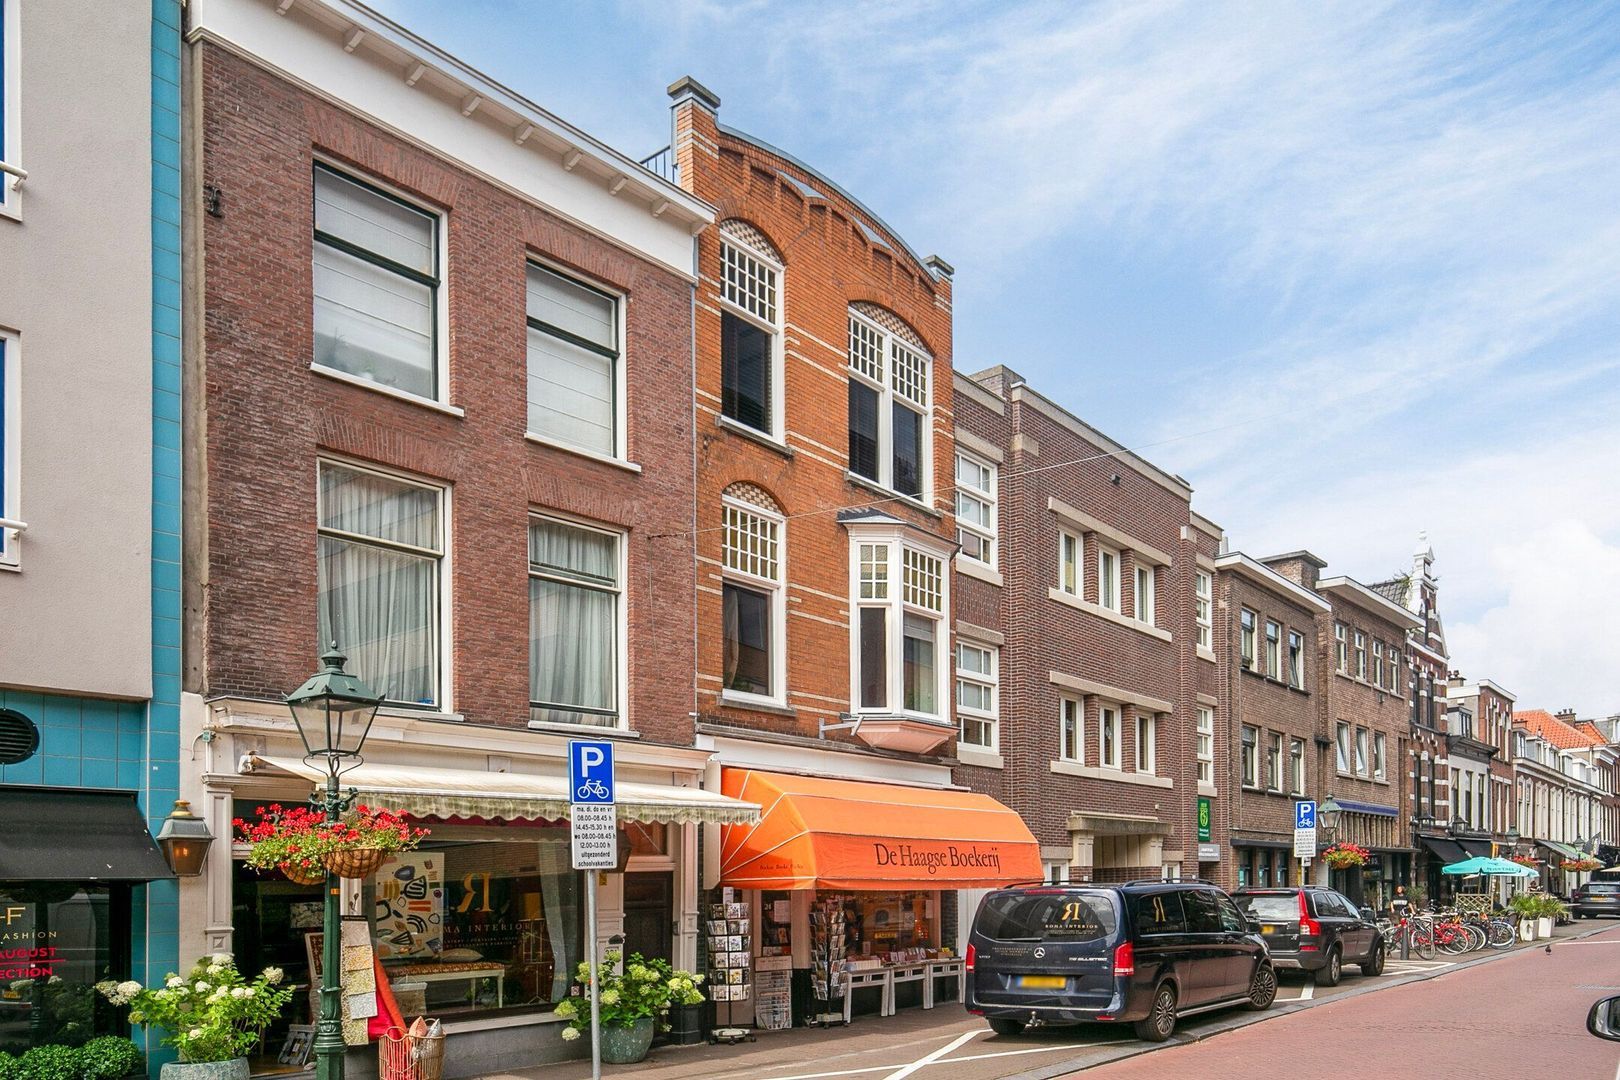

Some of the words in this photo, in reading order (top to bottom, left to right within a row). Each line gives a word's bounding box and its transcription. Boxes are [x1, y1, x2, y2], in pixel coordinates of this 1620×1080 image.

[581, 746, 604, 778] P
[1300, 804, 1312, 818] P
[581, 851, 610, 859] uitgezonderd
[873, 843, 897, 866] De
[899, 845, 947, 874] Haagse
[948, 846, 1000, 874] Boekerij
[468, 923, 530, 933] INTERIOR
